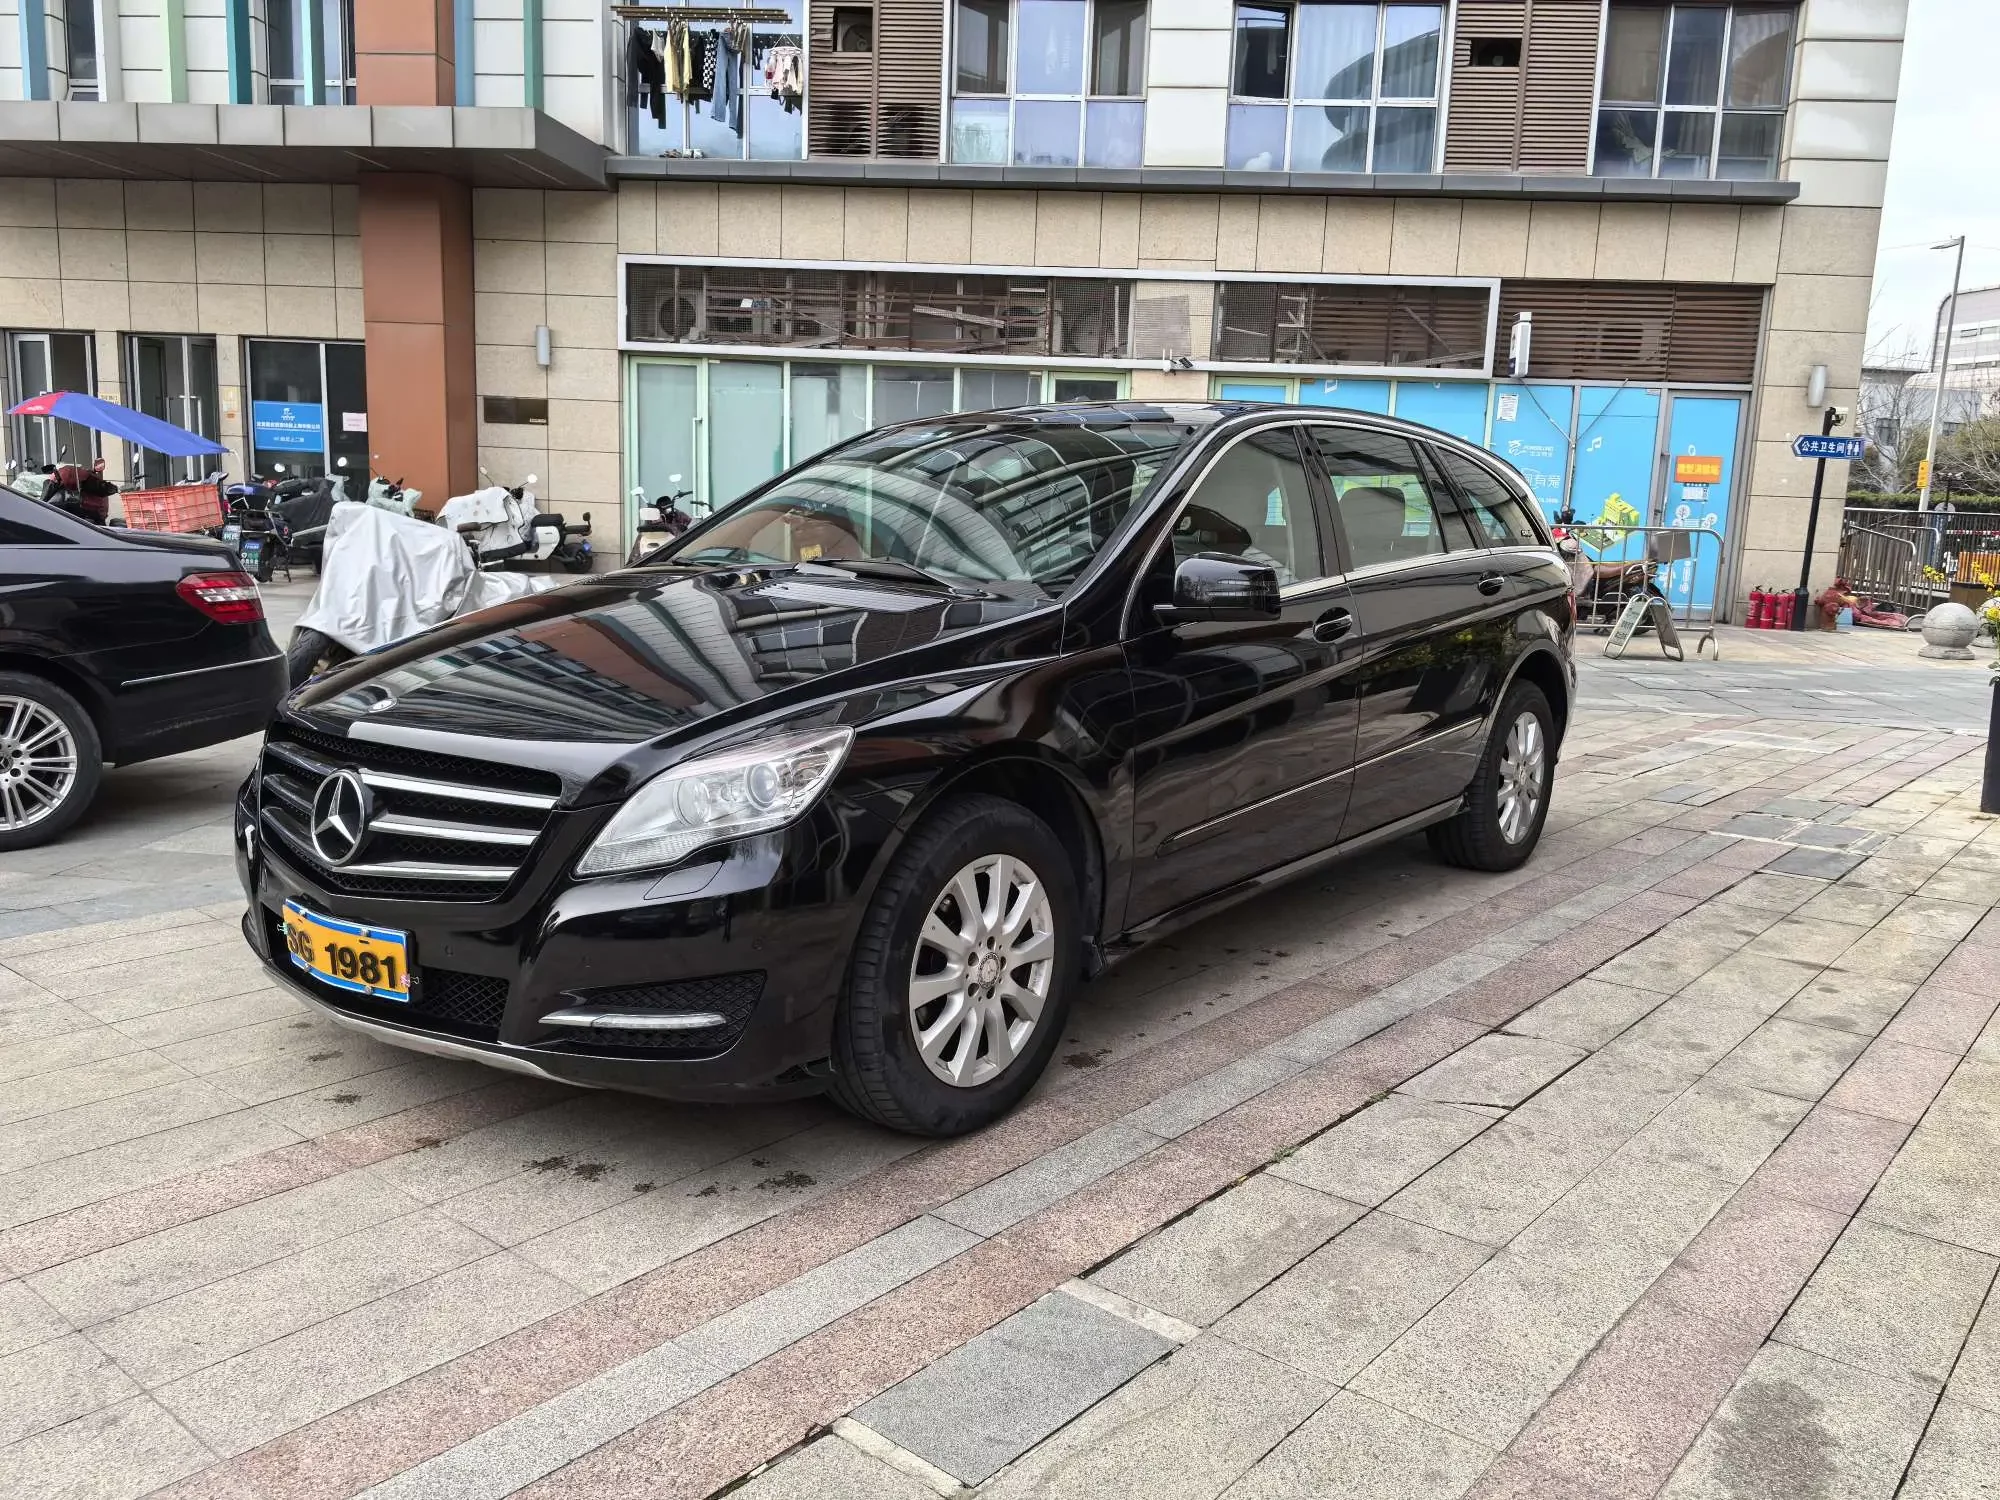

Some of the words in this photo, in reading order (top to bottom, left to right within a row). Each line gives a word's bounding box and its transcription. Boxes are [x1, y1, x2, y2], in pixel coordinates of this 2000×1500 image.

[1801, 440, 1845, 454] 公共卫生间
[324, 942, 396, 989] 1981
